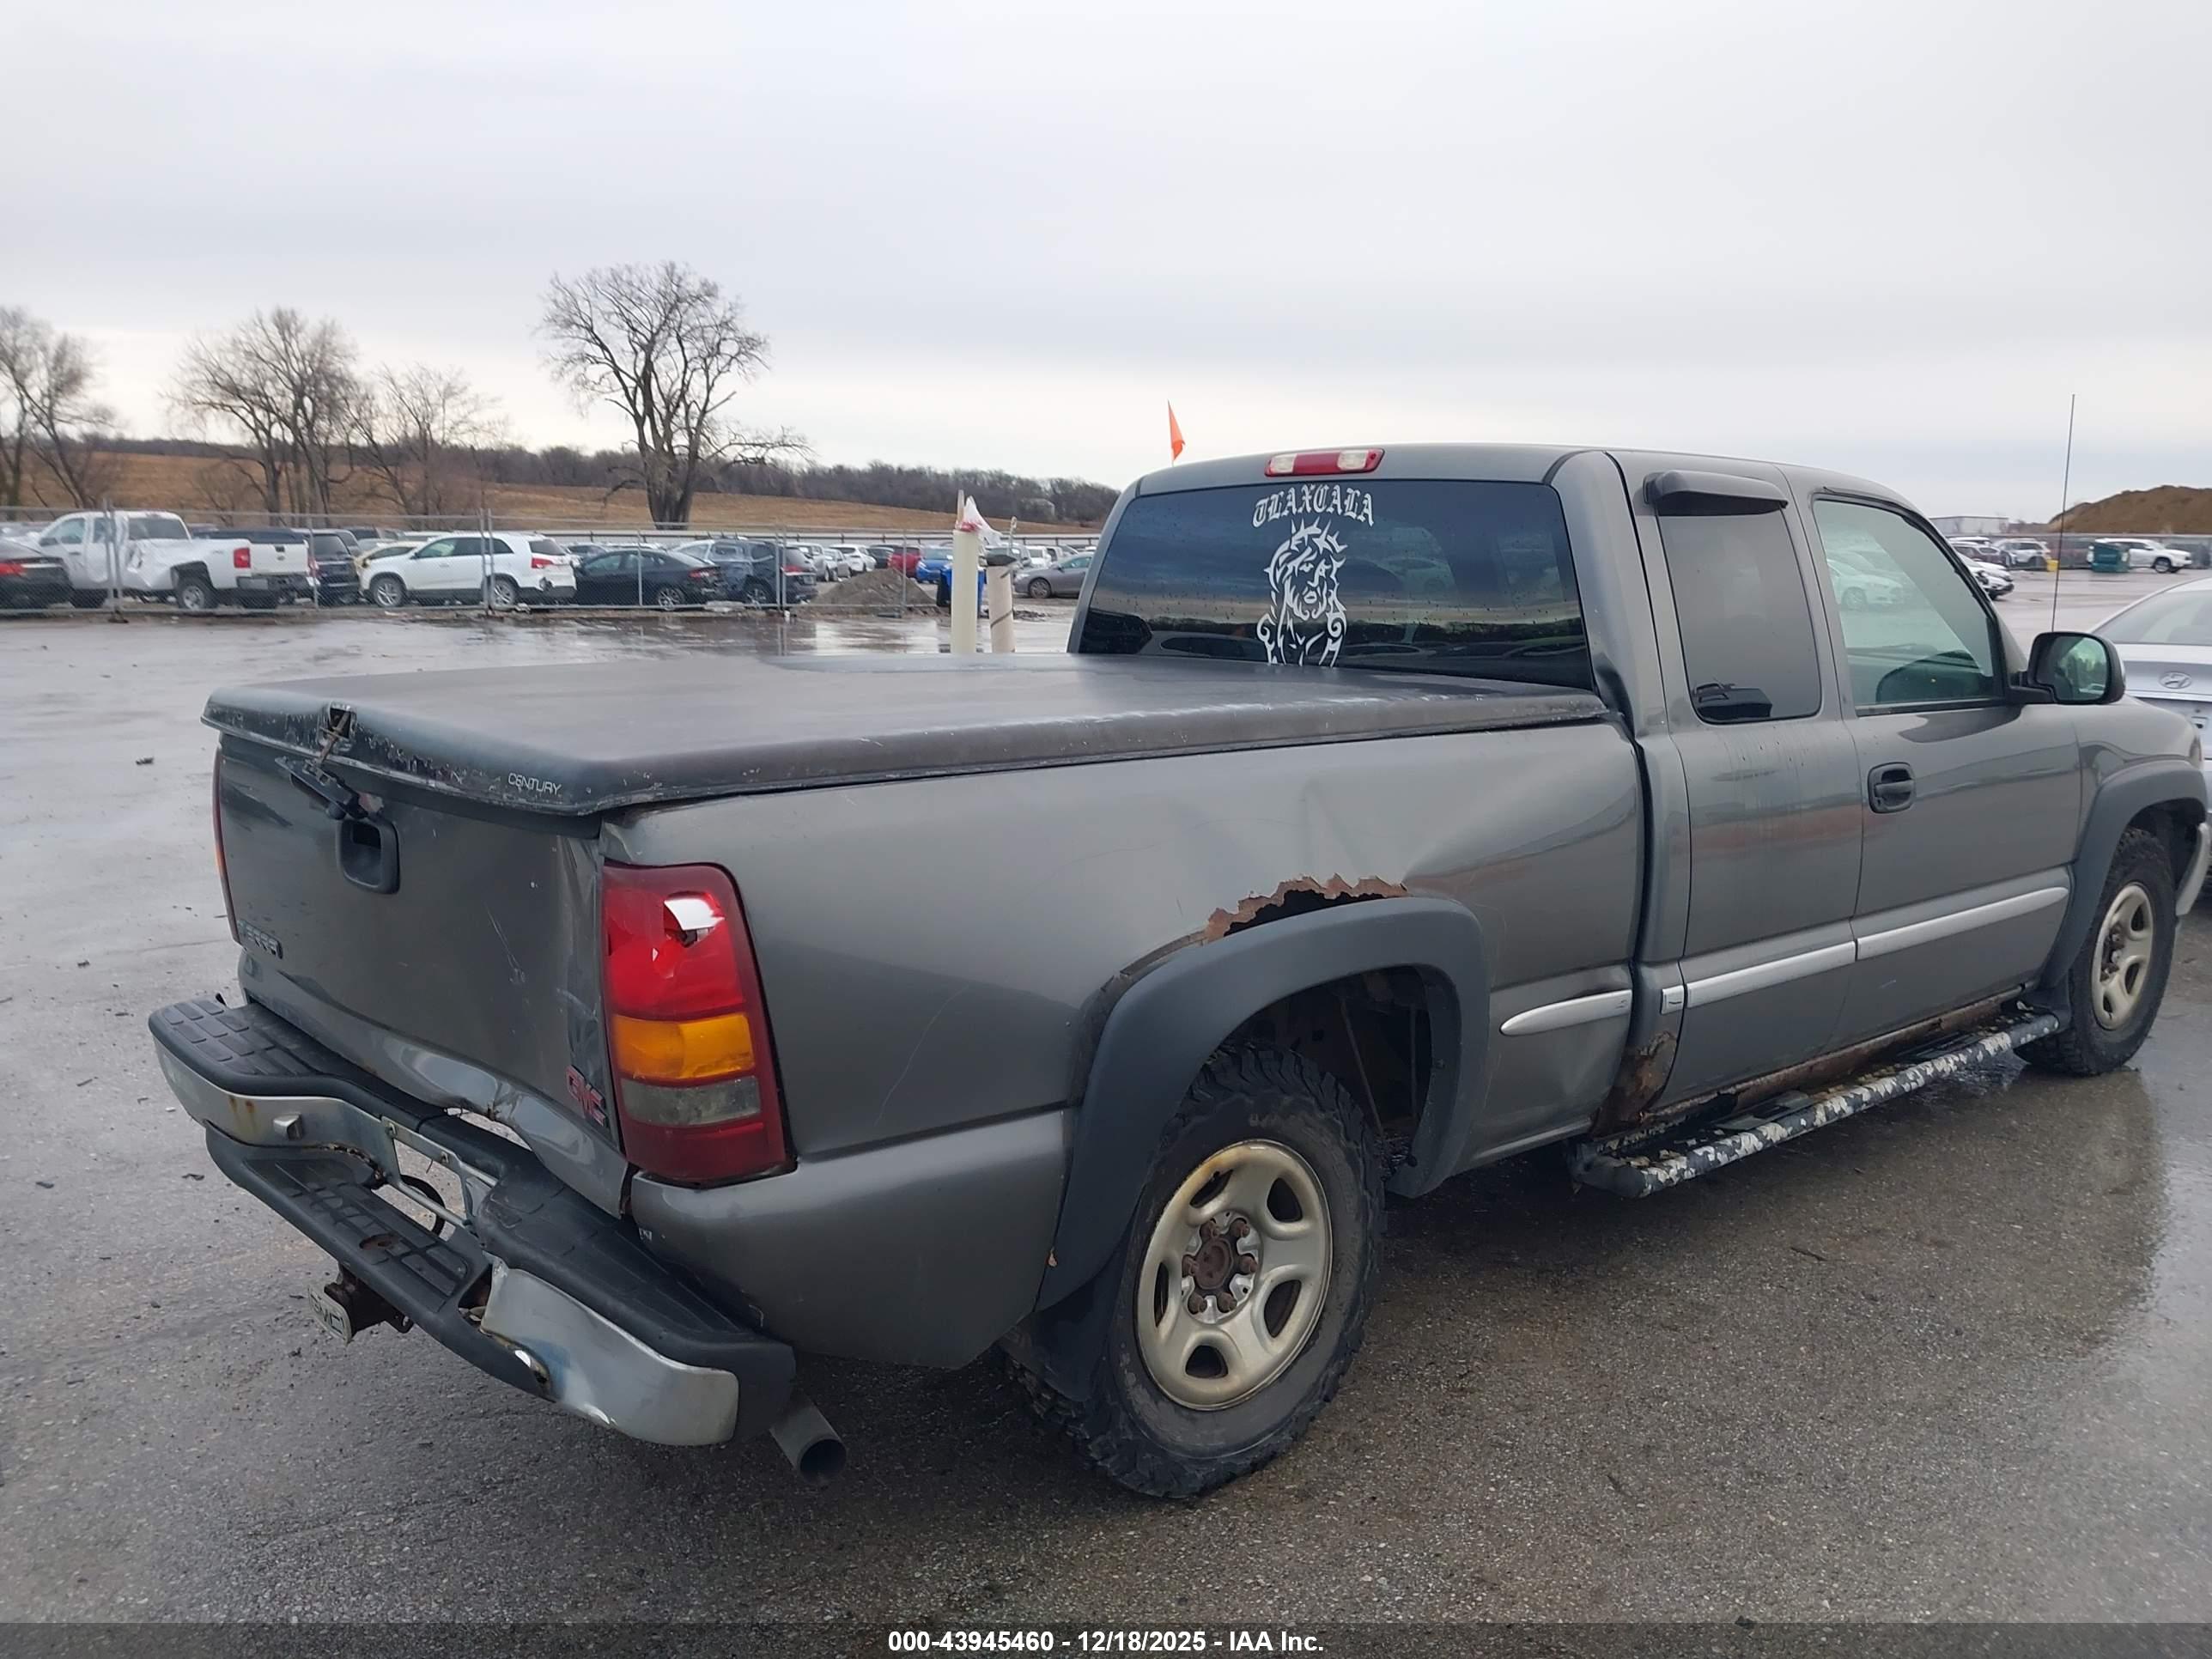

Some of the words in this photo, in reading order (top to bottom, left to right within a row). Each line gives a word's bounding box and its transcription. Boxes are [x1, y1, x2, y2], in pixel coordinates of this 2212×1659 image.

[1252, 483, 1374, 527] TLAXCALA
[507, 772, 562, 795] CENTURY
[566, 1065, 606, 1127] GMC
